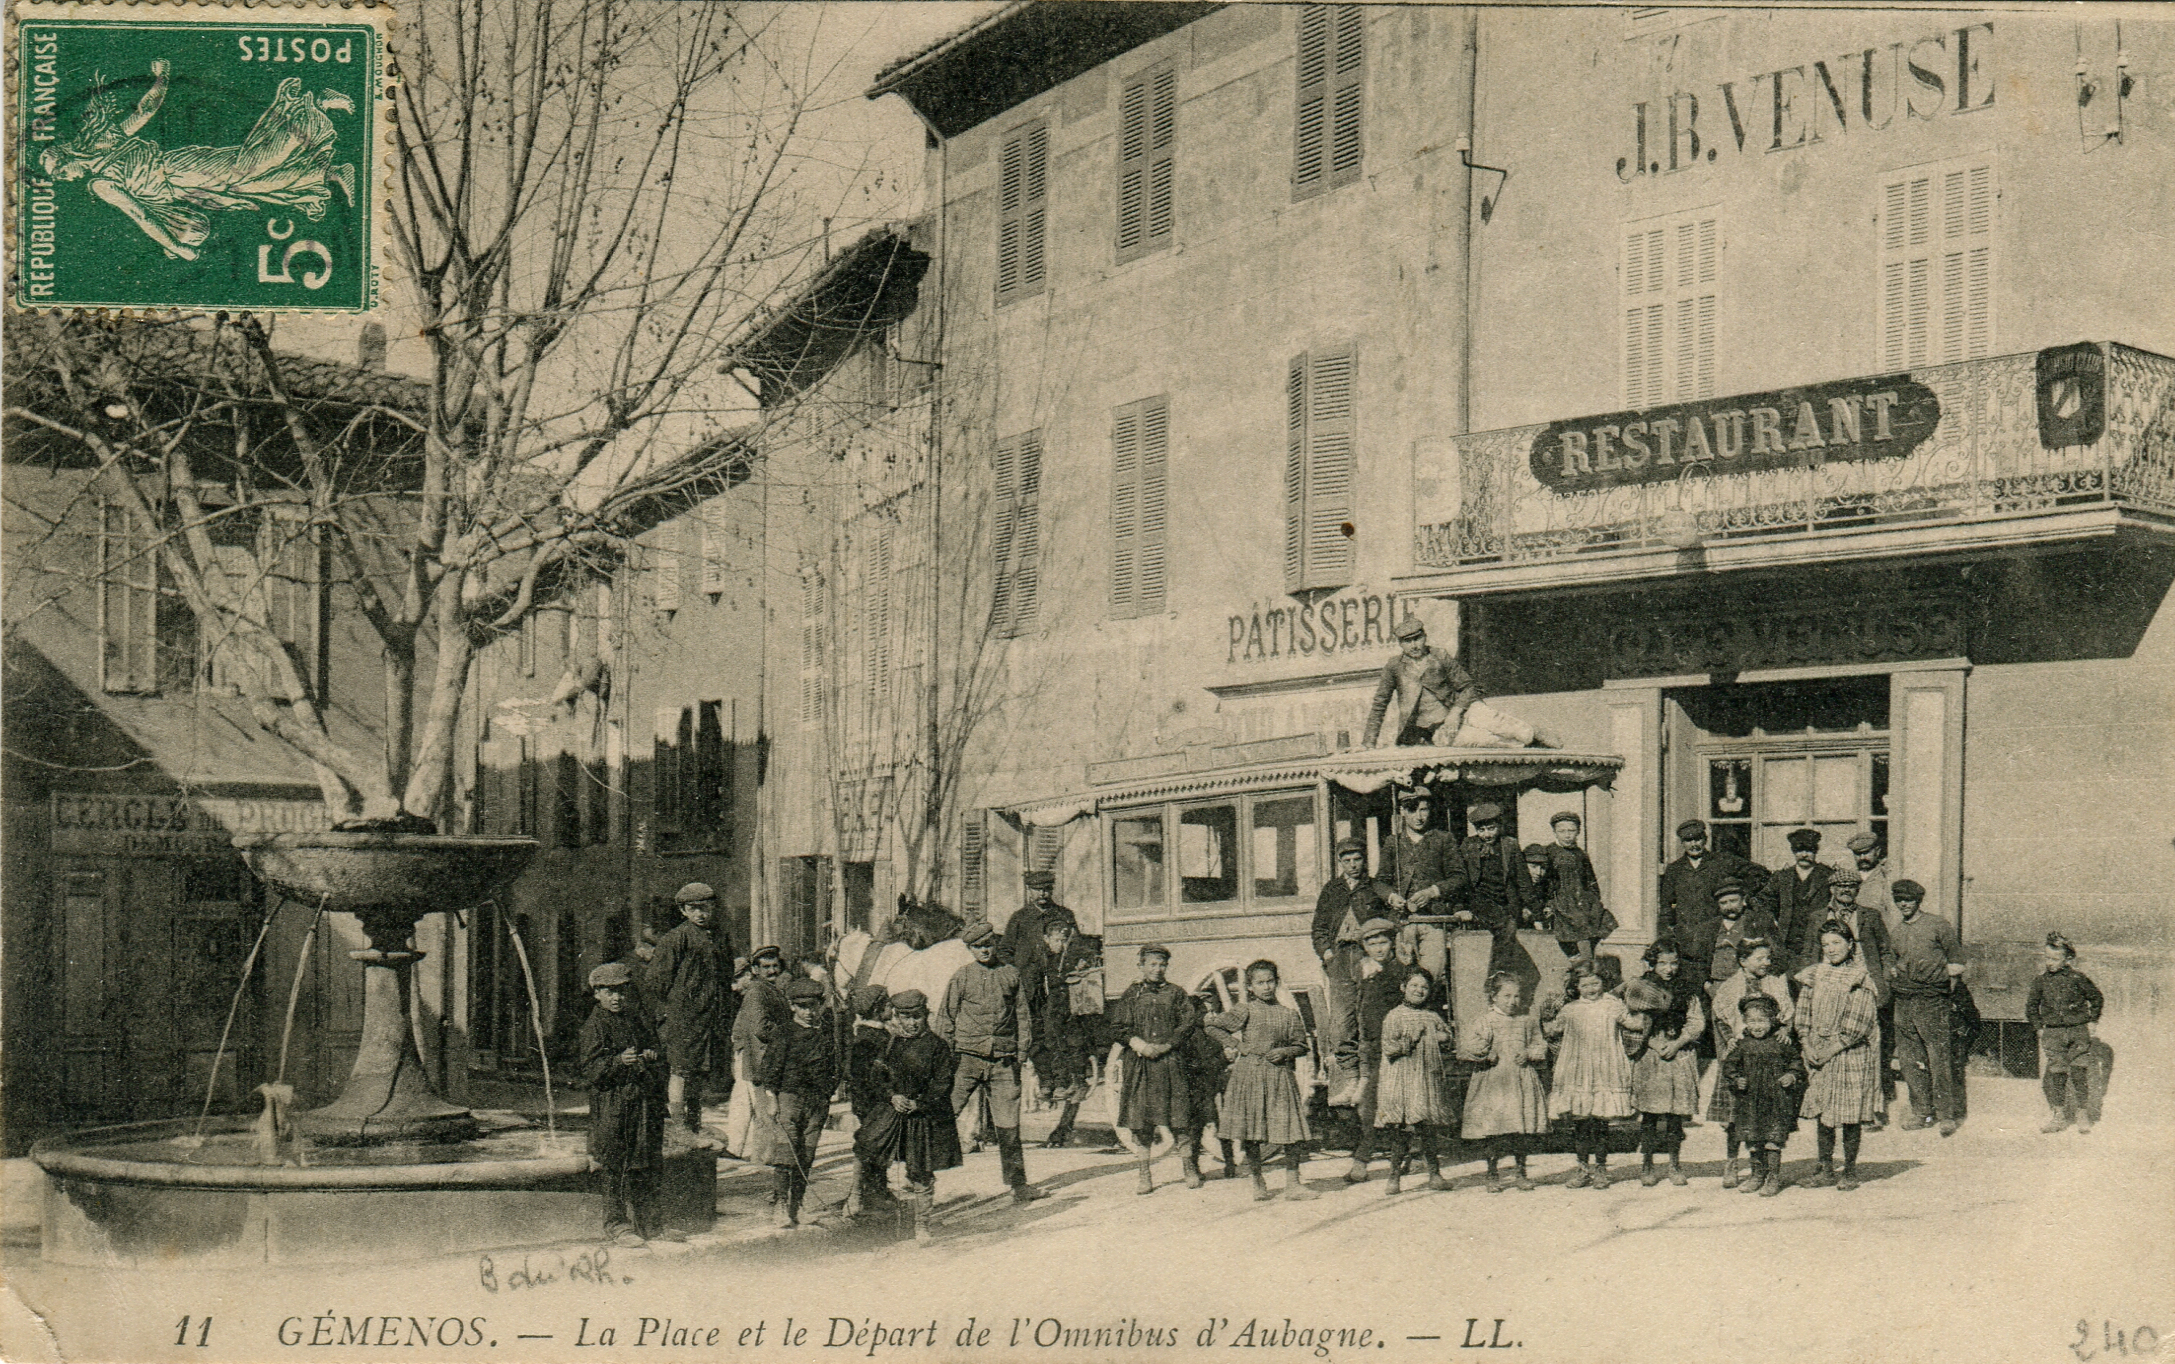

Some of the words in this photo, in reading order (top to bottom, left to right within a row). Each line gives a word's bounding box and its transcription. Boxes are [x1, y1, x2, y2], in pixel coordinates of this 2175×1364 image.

[238, 36, 352, 63] POSTES
[33, 32, 58, 141] FRANÇAISE
[1559, 391, 1899, 477] RESTAURANT
[2068, 1318, 2159, 1362] 240
